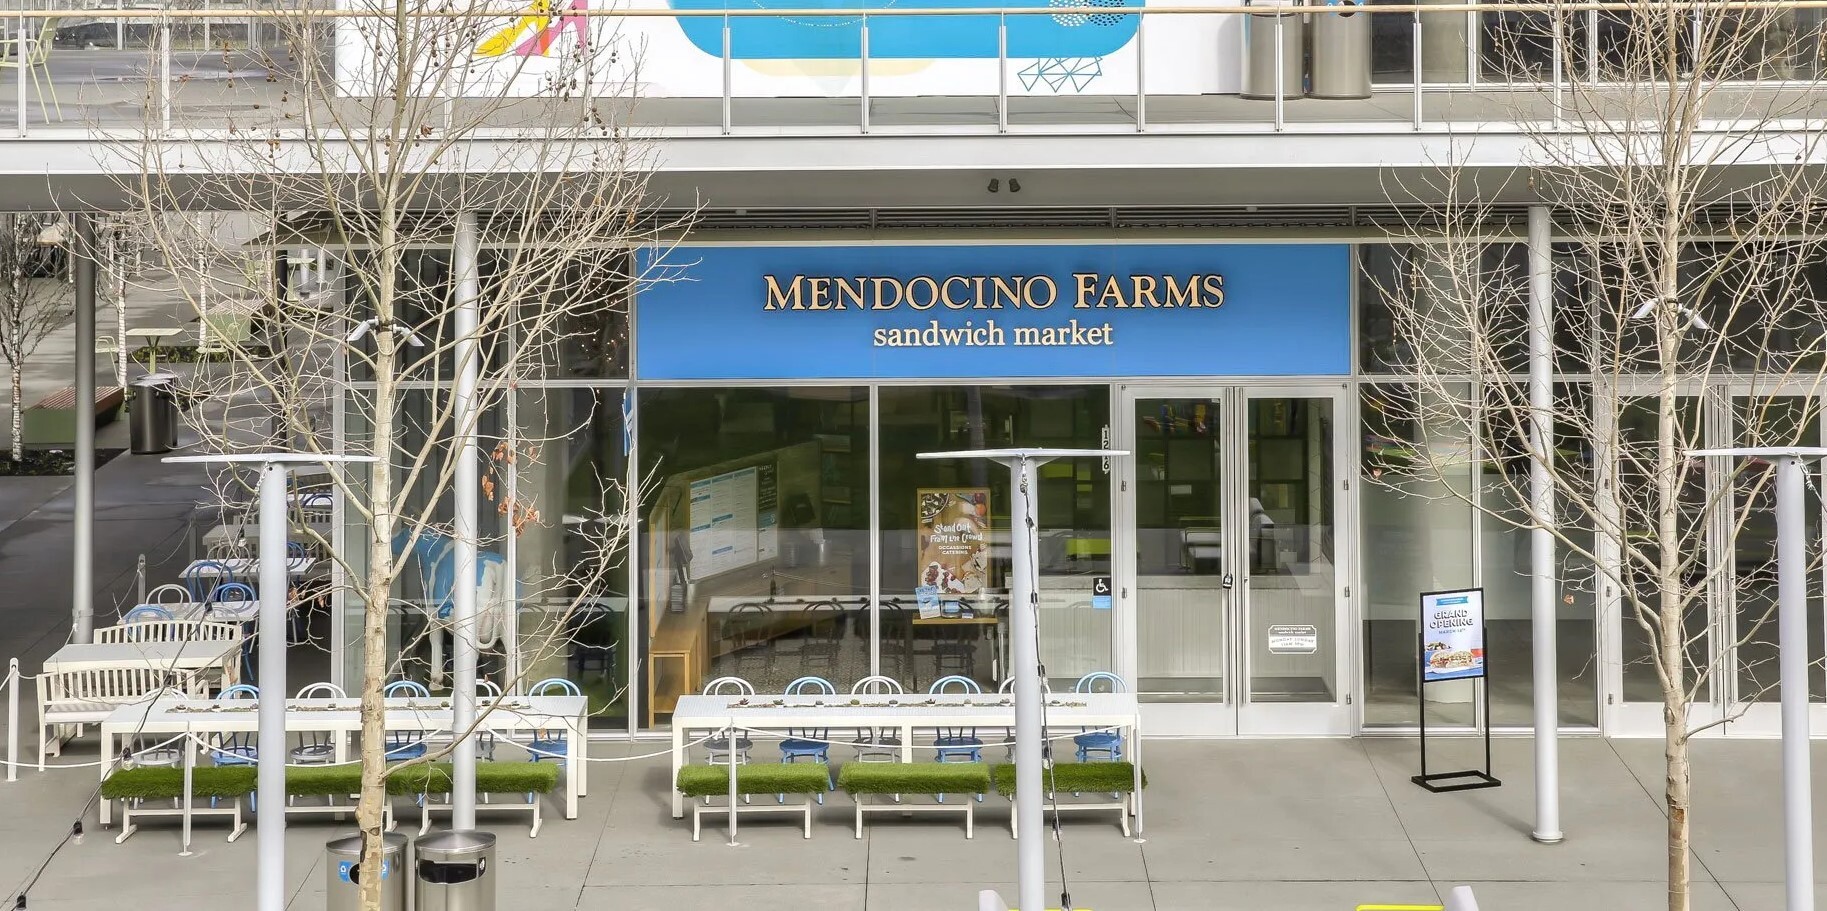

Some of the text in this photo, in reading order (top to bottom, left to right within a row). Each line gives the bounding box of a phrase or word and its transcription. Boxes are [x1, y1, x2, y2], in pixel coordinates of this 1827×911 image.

[763, 272, 1225, 310] MENDOCINO FARMS
[873, 320, 1113, 347] sandwich market
[935, 522, 971, 533] Stand Out
[962, 532, 983, 543] Crowd
[1434, 609, 1469, 620] GRAND
[1429, 618, 1474, 629] OPENING
